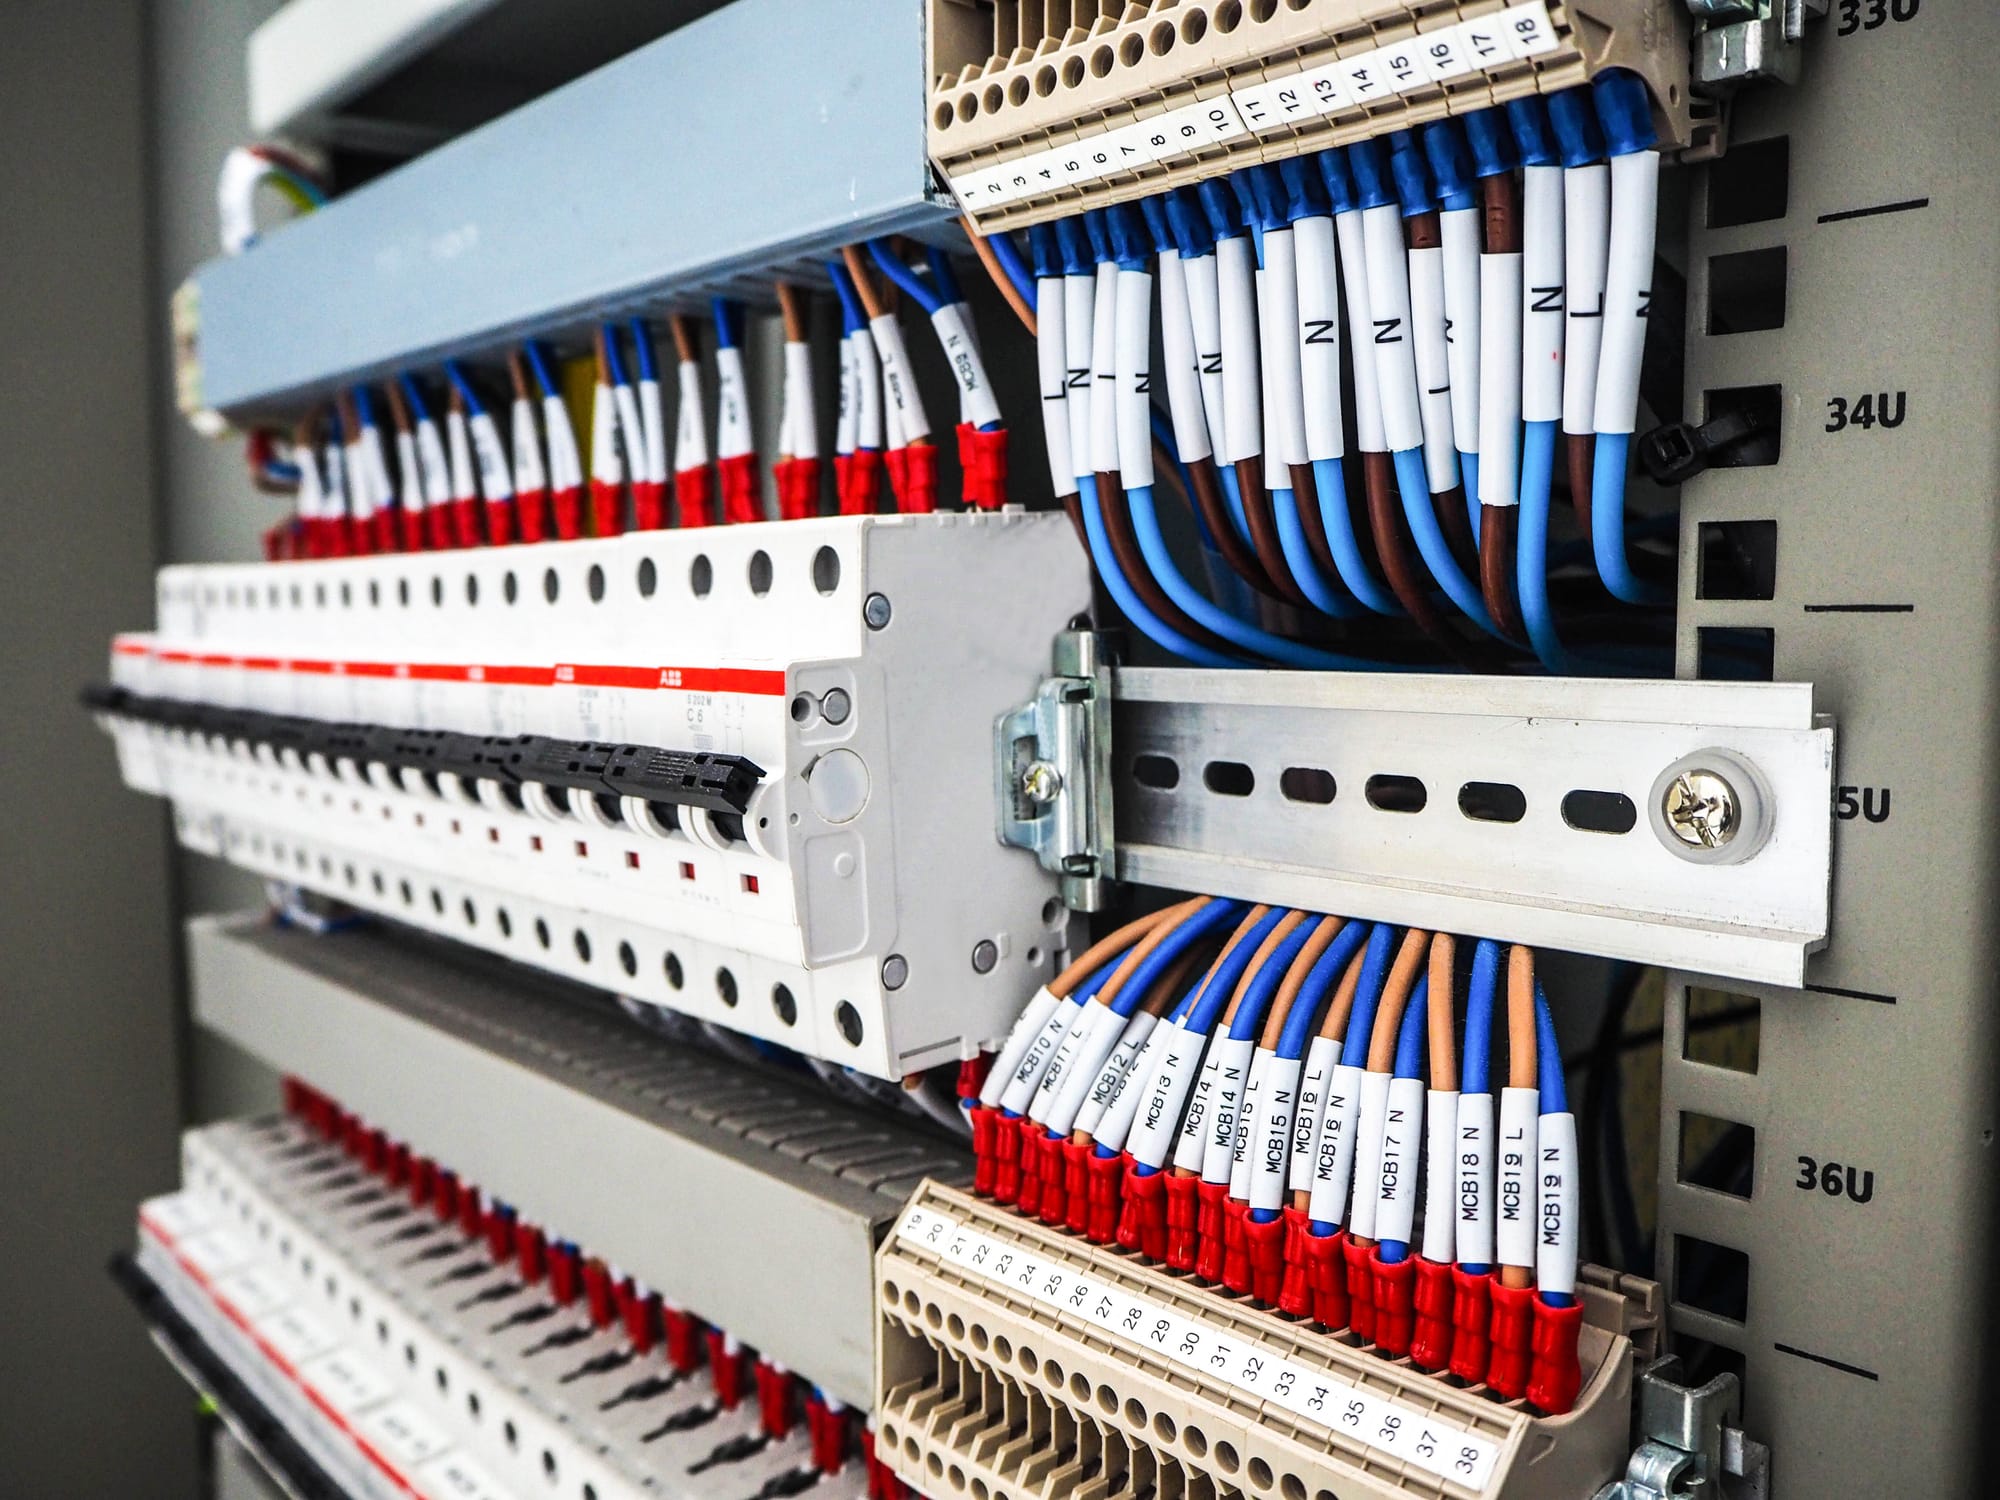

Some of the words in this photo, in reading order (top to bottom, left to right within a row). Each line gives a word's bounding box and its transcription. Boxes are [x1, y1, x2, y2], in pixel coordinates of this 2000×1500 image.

[1516, 19, 1538, 43] 18
[1431, 44, 1453, 68] 16
[1472, 35, 1494, 56] 17
[1390, 57, 1412, 80] 15
[1315, 80, 1335, 102] 13
[1352, 70, 1373, 91] 14
[1246, 102, 1265, 121] 11
[1279, 90, 1299, 112] 12
[1181, 126, 1195, 136] 9
[1209, 110, 1228, 131] 10
[1151, 135, 1165, 145] 8
[1093, 153, 1106, 163] 6
[1121, 147, 1135, 155] 7
[1039, 170, 1050, 178] 4
[1065, 161, 1079, 171] 5
[988, 184, 1001, 192] 2
[1014, 177, 1026, 185] 3
[1532, 287, 1562, 312] N
[1570, 292, 1603, 318] L
[1305, 320, 1334, 344] N
[1373, 319, 1402, 343] N
[1202, 352, 1223, 374] N
[1068, 368, 1091, 388] N
[1044, 381, 1066, 400] L
[1826, 392, 1906, 432] 34U
[660, 670, 682, 686] ABB
[687, 709, 694, 721] C
[697, 711, 703, 722] 6
[1838, 786, 1890, 822] 5U
[1017, 1037, 1050, 1083] MCB10
[1050, 1020, 1063, 1033] N
[1042, 1046, 1070, 1092] MCB11
[1071, 1030, 1082, 1038] L
[1091, 1054, 1128, 1104] MCB12
[1124, 1041, 1140, 1049] L
[1224, 1067, 1240, 1080] N
[1306, 1070, 1322, 1081] L
[1145, 1075, 1171, 1130] MCB13
[1166, 1054, 1180, 1067] N
[1184, 1080, 1212, 1136] MCB14
[1206, 1061, 1219, 1071] L
[1275, 1090, 1291, 1103] N
[1215, 1091, 1237, 1147] MCB14
[1234, 1103, 1254, 1163] MCB15
[1247, 1081, 1259, 1091] L
[1295, 1092, 1318, 1154] MCB16
[1388, 1110, 1404, 1122] N
[1266, 1115, 1287, 1173] MCB15
[1317, 1119, 1342, 1180] MCB16
[1330, 1095, 1345, 1108] N
[1462, 1127, 1479, 1140] N
[1505, 1128, 1523, 1140] L
[1543, 1148, 1560, 1161] N
[1381, 1135, 1401, 1200] MCB17
[1462, 1153, 1479, 1221] MCB18
[1503, 1154, 1522, 1221] MCB19
[1796, 1156, 1874, 1203] 36U
[1543, 1175, 1562, 1246] MCB19
[908, 1215, 921, 1229] 19
[927, 1224, 943, 1242] 20
[951, 1238, 966, 1254] 21
[973, 1245, 990, 1264] 22
[996, 1255, 1012, 1274] 23
[1020, 1265, 1035, 1284] 24
[1044, 1276, 1061, 1295] 25
[1070, 1286, 1088, 1306] 26
[1096, 1296, 1112, 1318] 27
[1125, 1309, 1141, 1330] 28
[1151, 1320, 1169, 1342] 29
[1180, 1333, 1199, 1354] 30
[1211, 1346, 1230, 1367] 31
[1243, 1358, 1263, 1378] 32
[1275, 1372, 1295, 1395] 33
[1309, 1387, 1328, 1410] 34
[1344, 1403, 1364, 1425] 35
[1380, 1416, 1400, 1441] 36
[1417, 1431, 1436, 1457] 37
[1456, 1448, 1477, 1473] 38
